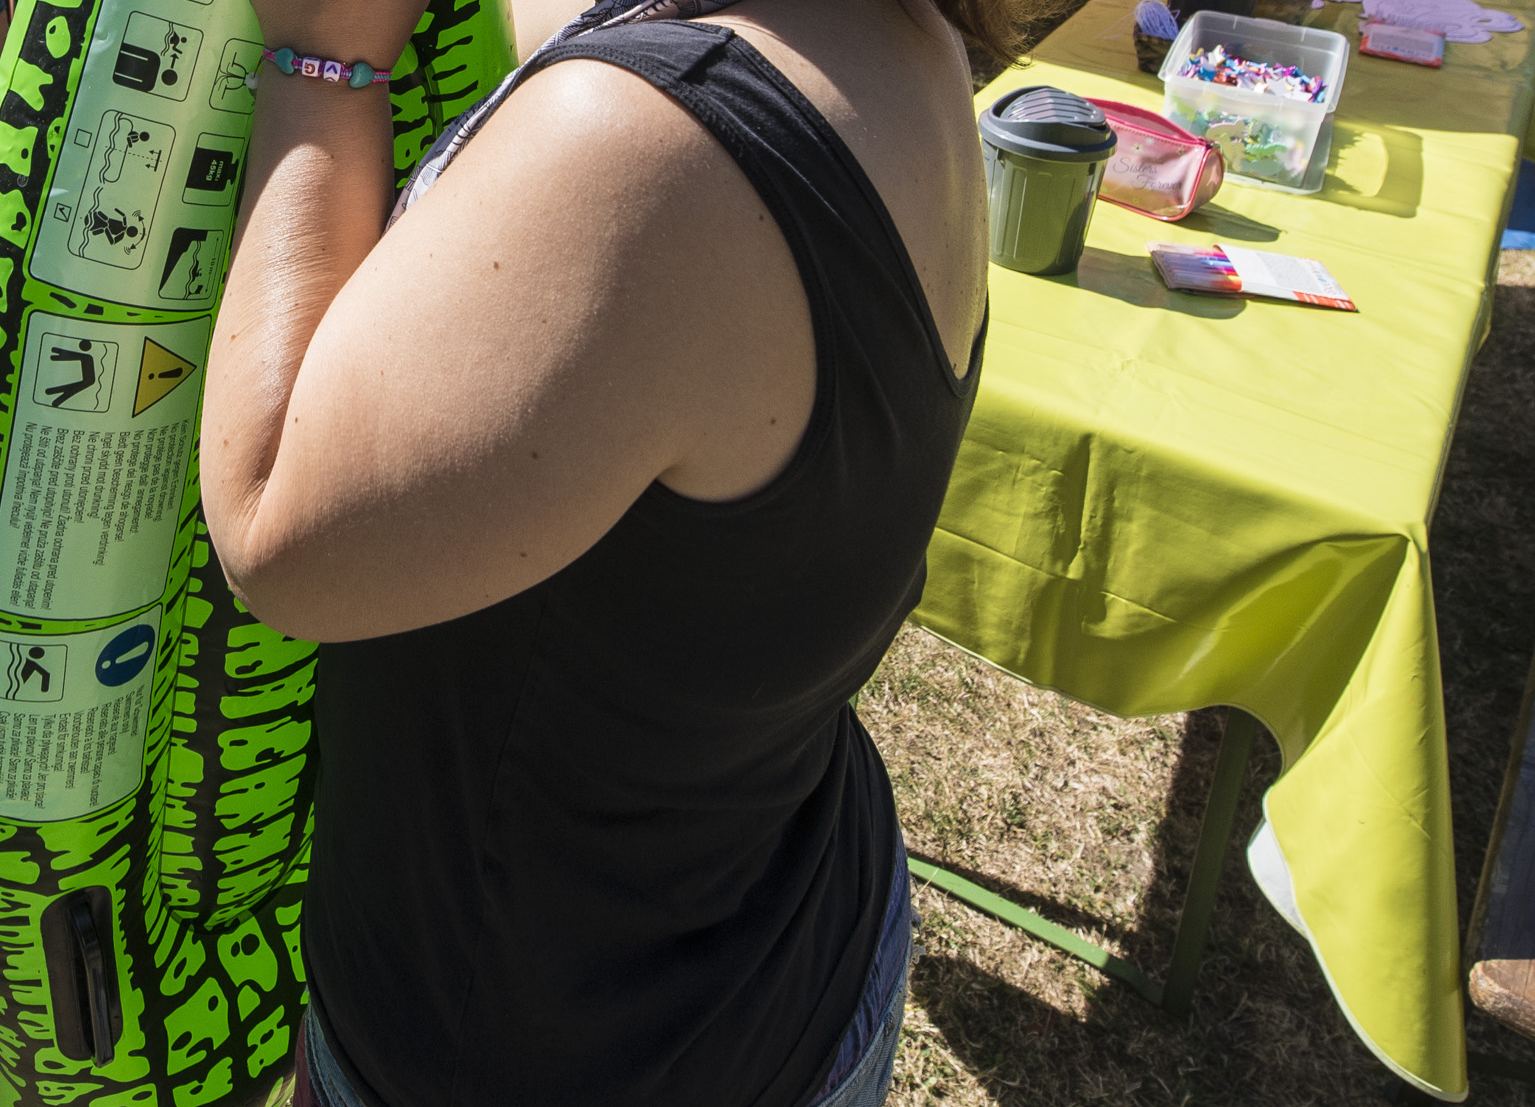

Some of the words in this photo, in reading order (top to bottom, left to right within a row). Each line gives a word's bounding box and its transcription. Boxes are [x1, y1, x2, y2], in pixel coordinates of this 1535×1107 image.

[206, 159, 218, 182] 45kg
[1112, 156, 1159, 174] Sisters
[1131, 174, 1183, 190] Forever
[55, 427, 69, 444] Brez
[71, 429, 85, 443] Bez
[87, 431, 100, 443] Nie
[133, 429, 144, 440] No
[113, 449, 124, 466] geen
[80, 466, 91, 484] przed
[95, 471, 106, 484] mot
[120, 501, 130, 509] de
